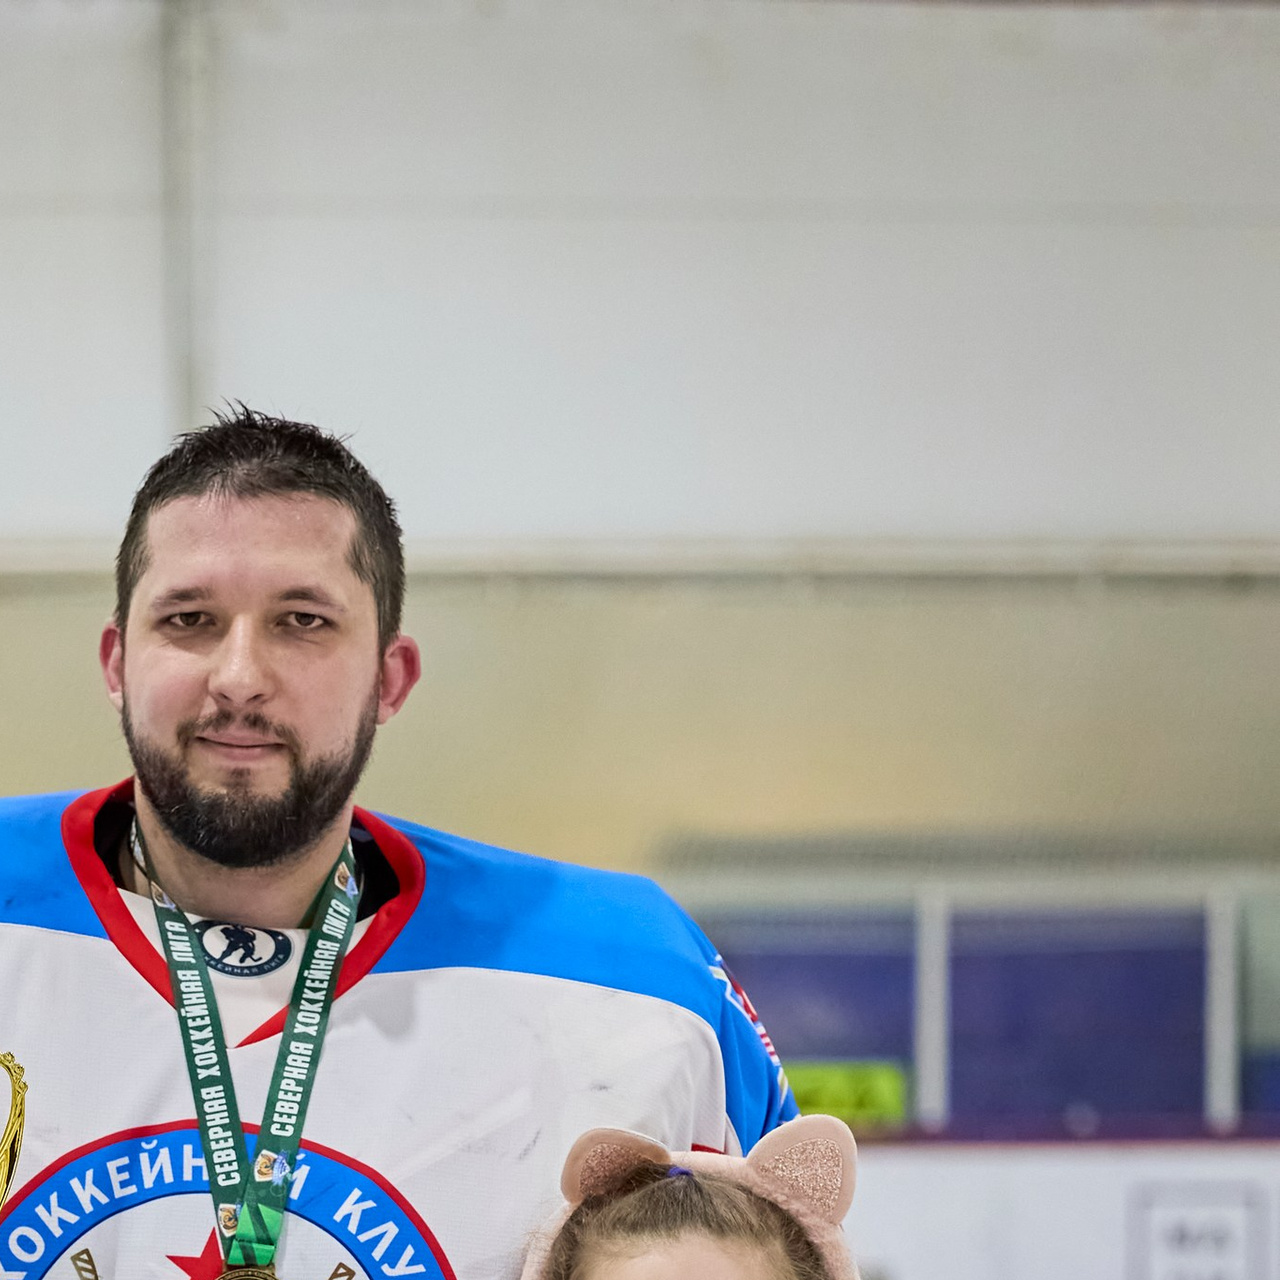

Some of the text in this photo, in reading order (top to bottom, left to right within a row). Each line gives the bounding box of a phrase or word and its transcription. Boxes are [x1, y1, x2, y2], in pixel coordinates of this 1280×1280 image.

[164, 921, 241, 1187] СЕВЕРНАЯ ХОККЕЙНАЯ ЛИГА
[270, 898, 352, 1138] СЕВЕРНАЯ ХОККЕЙНАЯ ЛИГА
